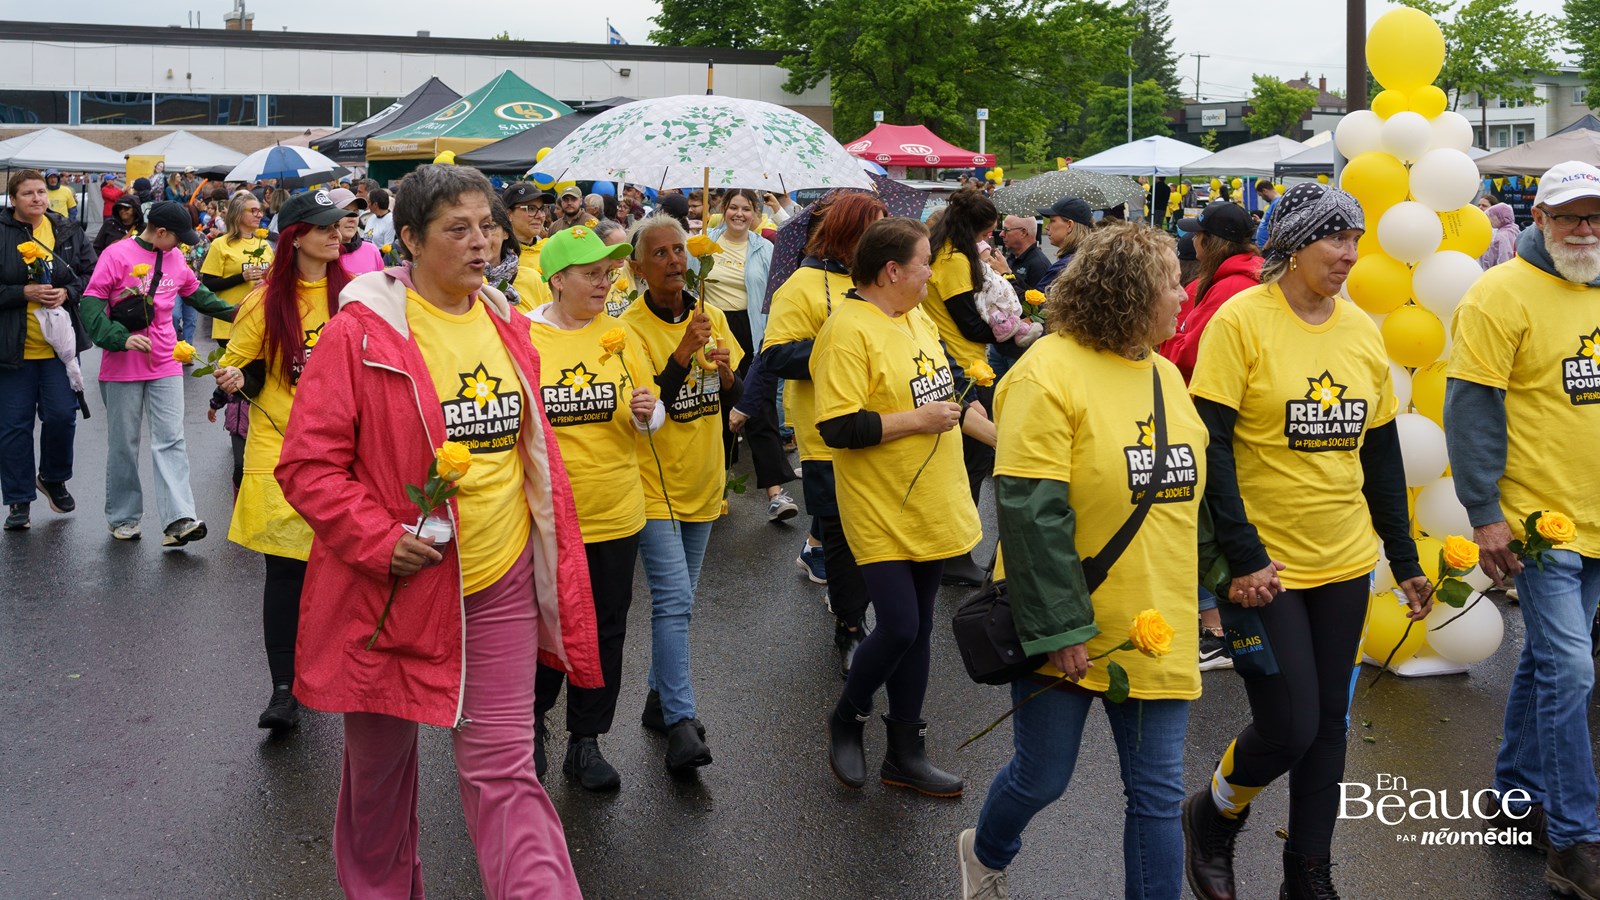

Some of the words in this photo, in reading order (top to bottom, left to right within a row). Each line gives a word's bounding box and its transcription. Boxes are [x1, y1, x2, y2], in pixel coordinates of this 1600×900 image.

[338, 139, 364, 148] MARTINEAU
[243, 262, 269, 271] REIS
[1566, 359, 1600, 377] REL
[912, 368, 951, 397] RELAIS
[543, 384, 614, 404] RELAIS
[443, 395, 520, 425] RELAIS
[545, 403, 578, 413] POUR
[580, 402, 595, 411] LA
[596, 399, 614, 409] VIE
[671, 399, 695, 411] OUR
[1290, 401, 1364, 422] RELAIS
[446, 423, 485, 439] POUR
[486, 420, 502, 434] LA
[501, 417, 519, 431] VIE
[1288, 423, 1324, 434] POUR
[1325, 423, 1342, 434] LA
[1343, 422, 1362, 433] VIE
[1303, 438, 1322, 448] PREND
[1132, 472, 1152, 486] PO
[1175, 469, 1195, 482] VIE
[1232, 636, 1261, 648] RELAIS
